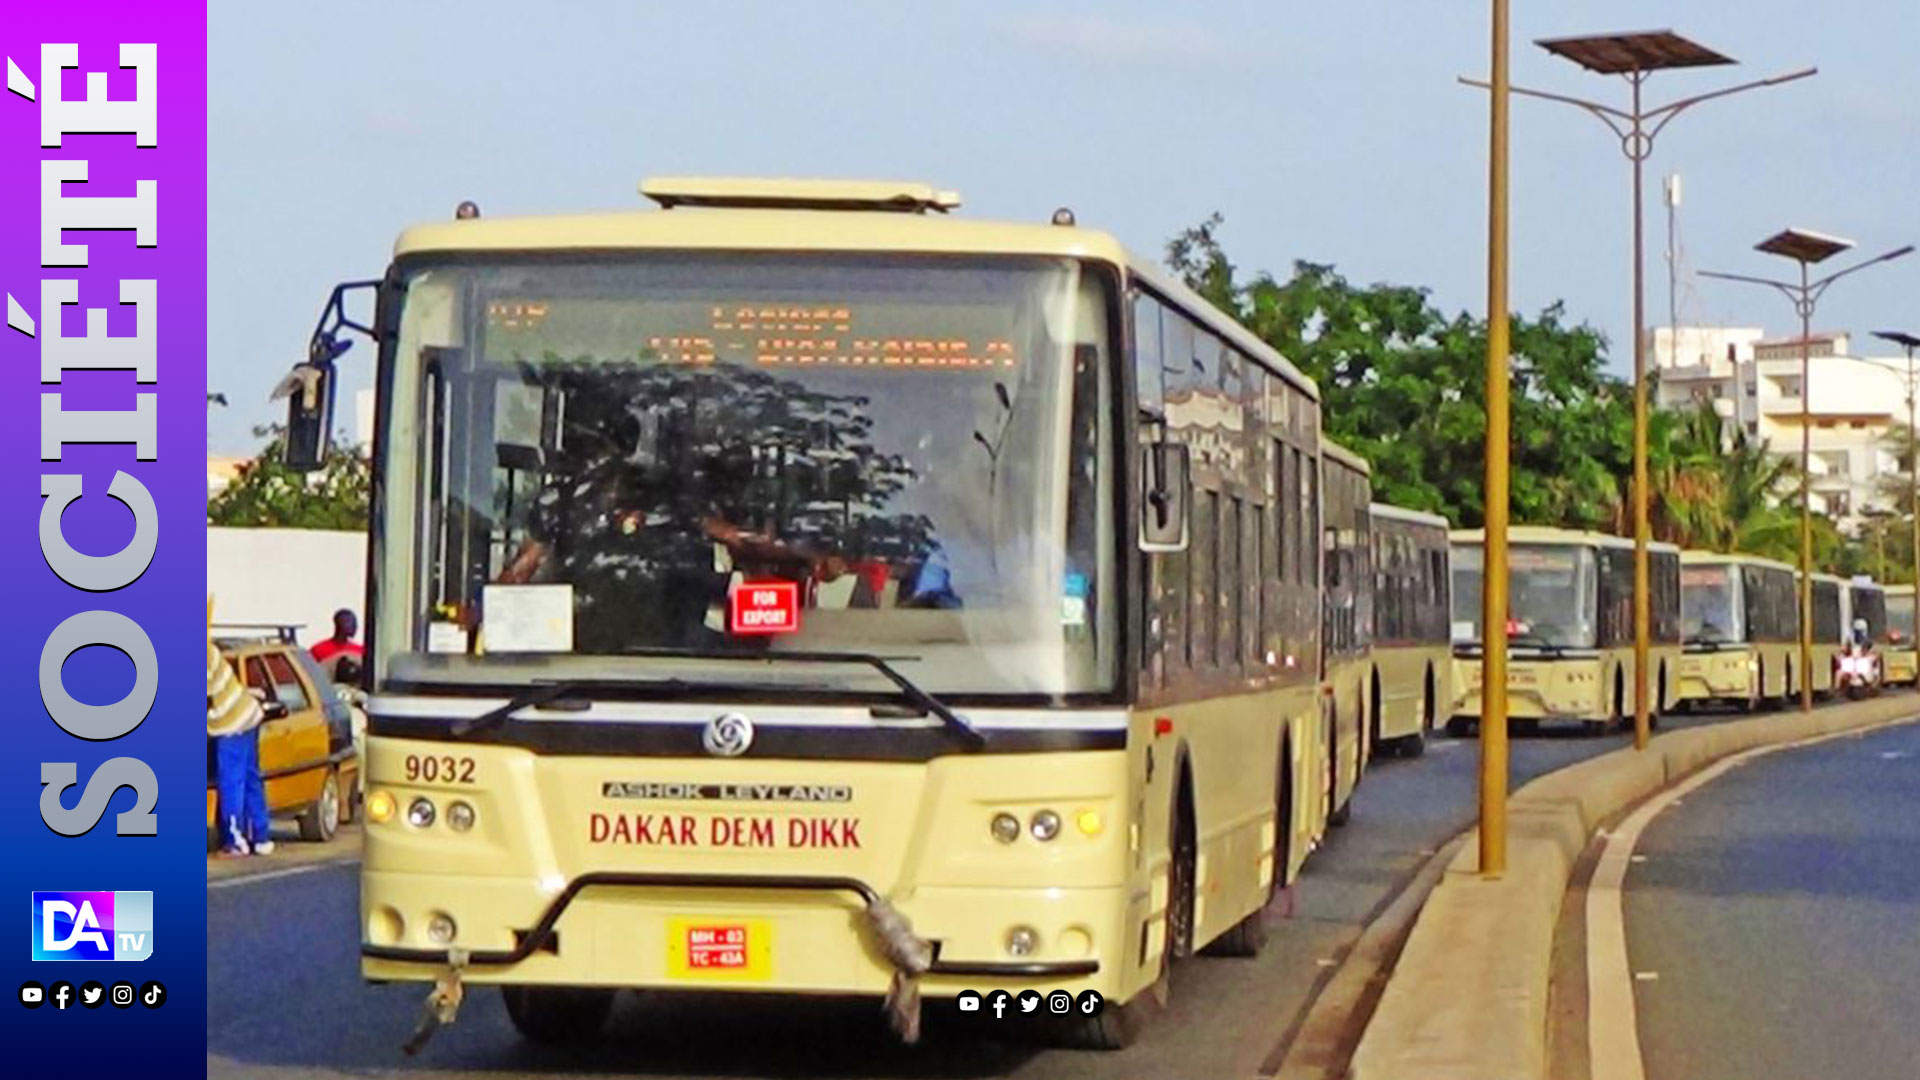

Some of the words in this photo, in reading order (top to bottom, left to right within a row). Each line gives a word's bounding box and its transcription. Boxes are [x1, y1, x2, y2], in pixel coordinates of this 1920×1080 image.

[752, 590, 778, 606] FOR
[743, 609, 787, 625] EXPORT
[405, 754, 476, 783] 9032
[605, 783, 701, 798] ASHOK
[719, 784, 850, 800] LEYLAND
[590, 813, 698, 845] DAKAR
[710, 816, 775, 847] DEM
[788, 817, 861, 848] DIKK
